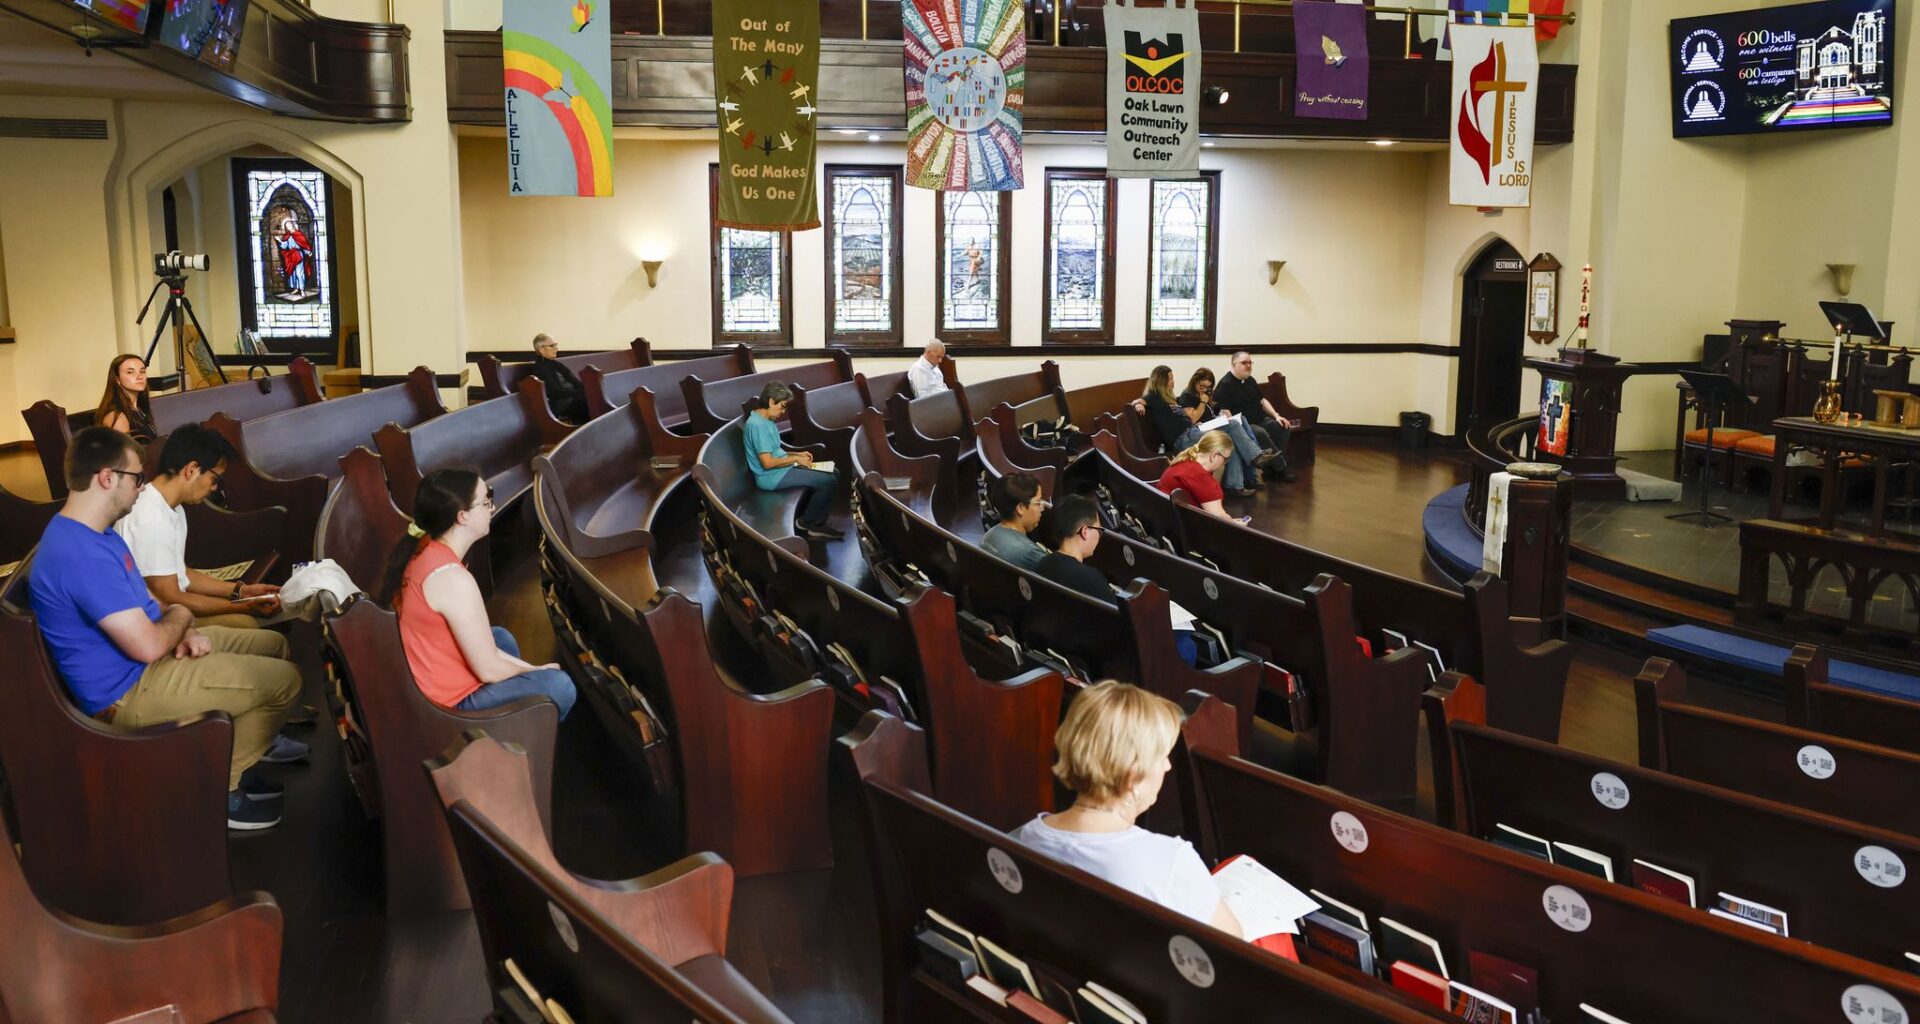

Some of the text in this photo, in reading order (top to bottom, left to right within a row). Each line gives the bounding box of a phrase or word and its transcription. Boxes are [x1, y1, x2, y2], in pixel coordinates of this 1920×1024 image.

[740, 18, 791, 32] Out of
[925, 10, 950, 43] BOLIVIA
[963, 25, 976, 43] RICO
[1738, 30, 1796, 47] 600 bells
[730, 37, 804, 56] The Many
[903, 38, 934, 67] PANAMA
[1693, 29, 1717, 39] SERVICE
[1717, 39, 1725, 62] JUSTICE
[1739, 44, 1793, 56] one witness
[1001, 43, 1026, 69] SPAIN
[906, 66, 925, 82] PERU
[1738, 67, 1761, 80] 600
[1761, 77, 1786, 86] testigo
[1127, 75, 1184, 94] OLCOC
[1697, 80, 1719, 89] SERVICIO
[1124, 97, 1184, 114] Oak Lawn
[1299, 91, 1364, 109] Pray without ceasing
[1121, 113, 1188, 134] Community
[1507, 95, 1516, 159] JESUS
[507, 88, 522, 192] ALLELUIA
[914, 121, 942, 158] ECUADOR
[1124, 129, 1180, 146] Outreach
[951, 133, 967, 187] NICARAGUA
[980, 134, 1006, 182] ARGENTINA
[1133, 147, 1173, 161] Center
[731, 163, 807, 179] God Makes
[1514, 160, 1525, 174] IS
[1499, 174, 1529, 187] LORD
[742, 186, 796, 200] Us One
[1495, 261, 1518, 269] RESTROOMS
